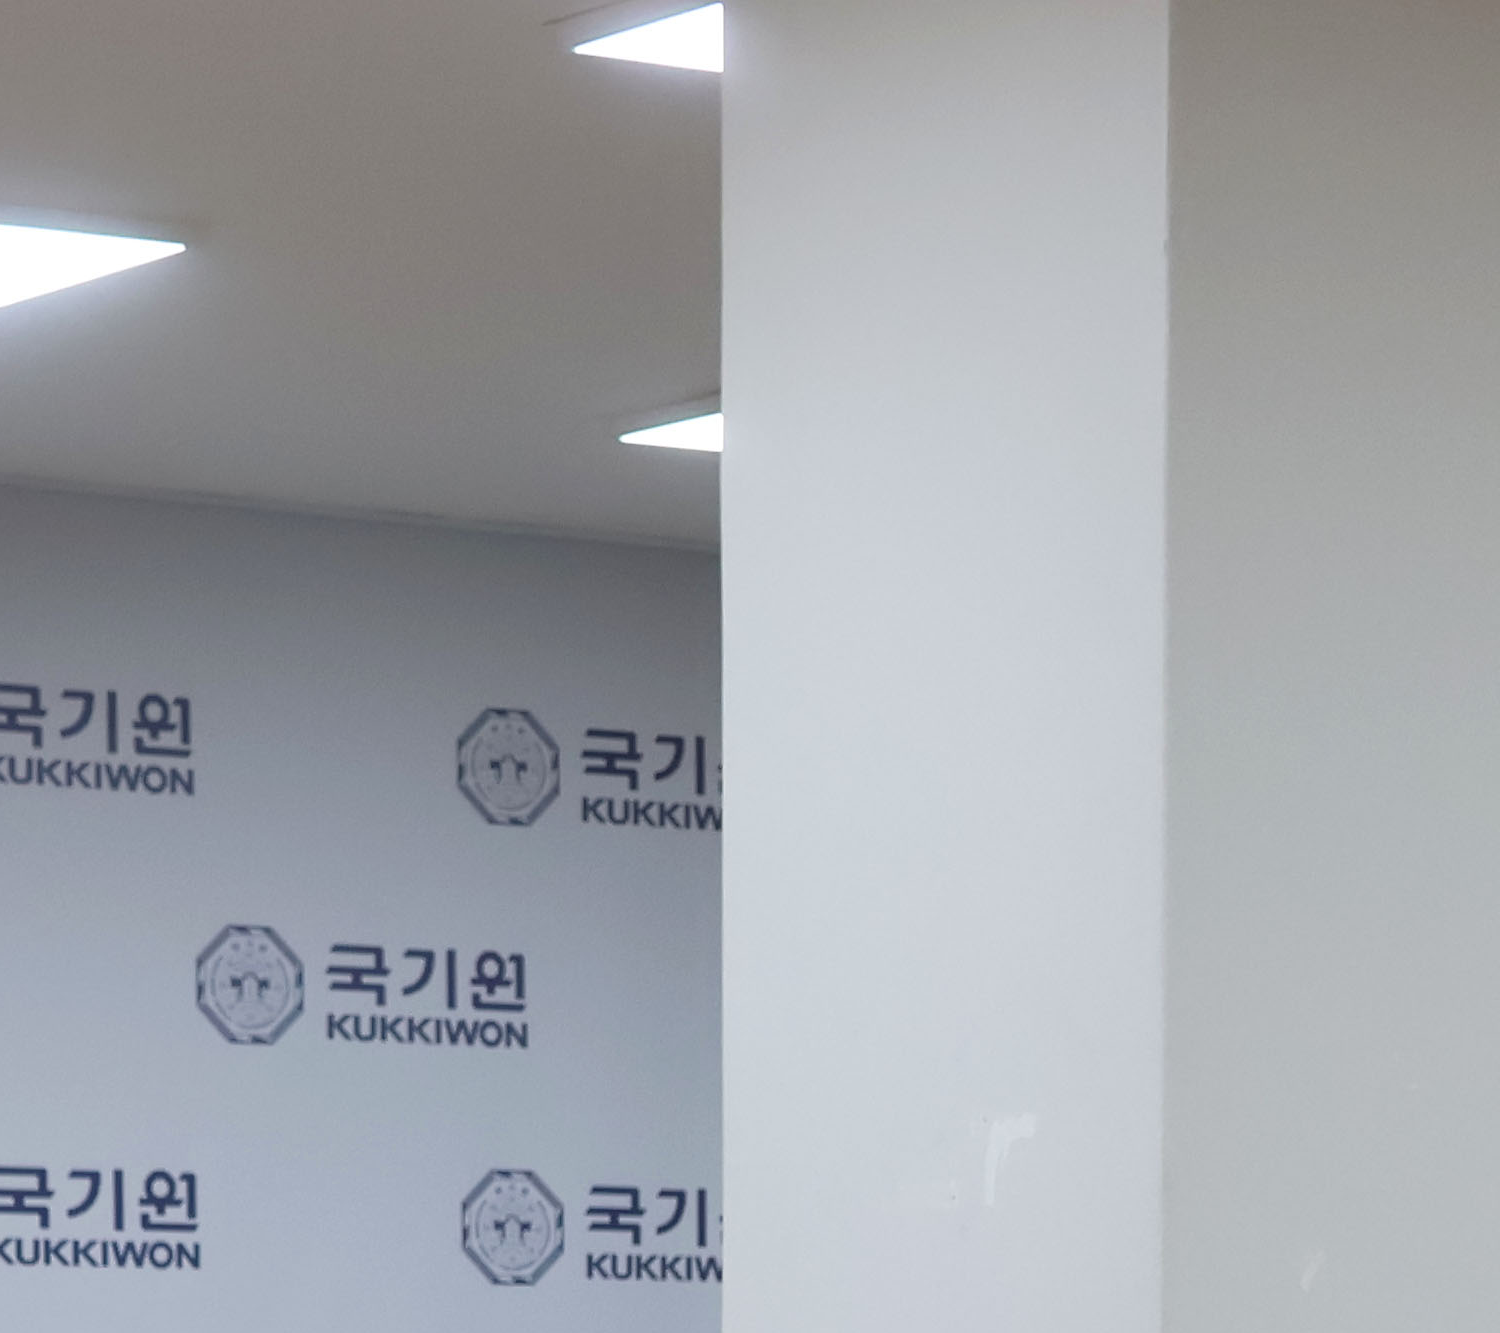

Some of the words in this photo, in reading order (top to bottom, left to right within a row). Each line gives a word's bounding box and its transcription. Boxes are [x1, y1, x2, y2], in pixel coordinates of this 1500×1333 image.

[581, 727, 722, 796] 국기
[326, 943, 528, 1013] 국기원
[327, 1013, 529, 1050] KUKKIWON
[586, 1185, 722, 1248] 국기
